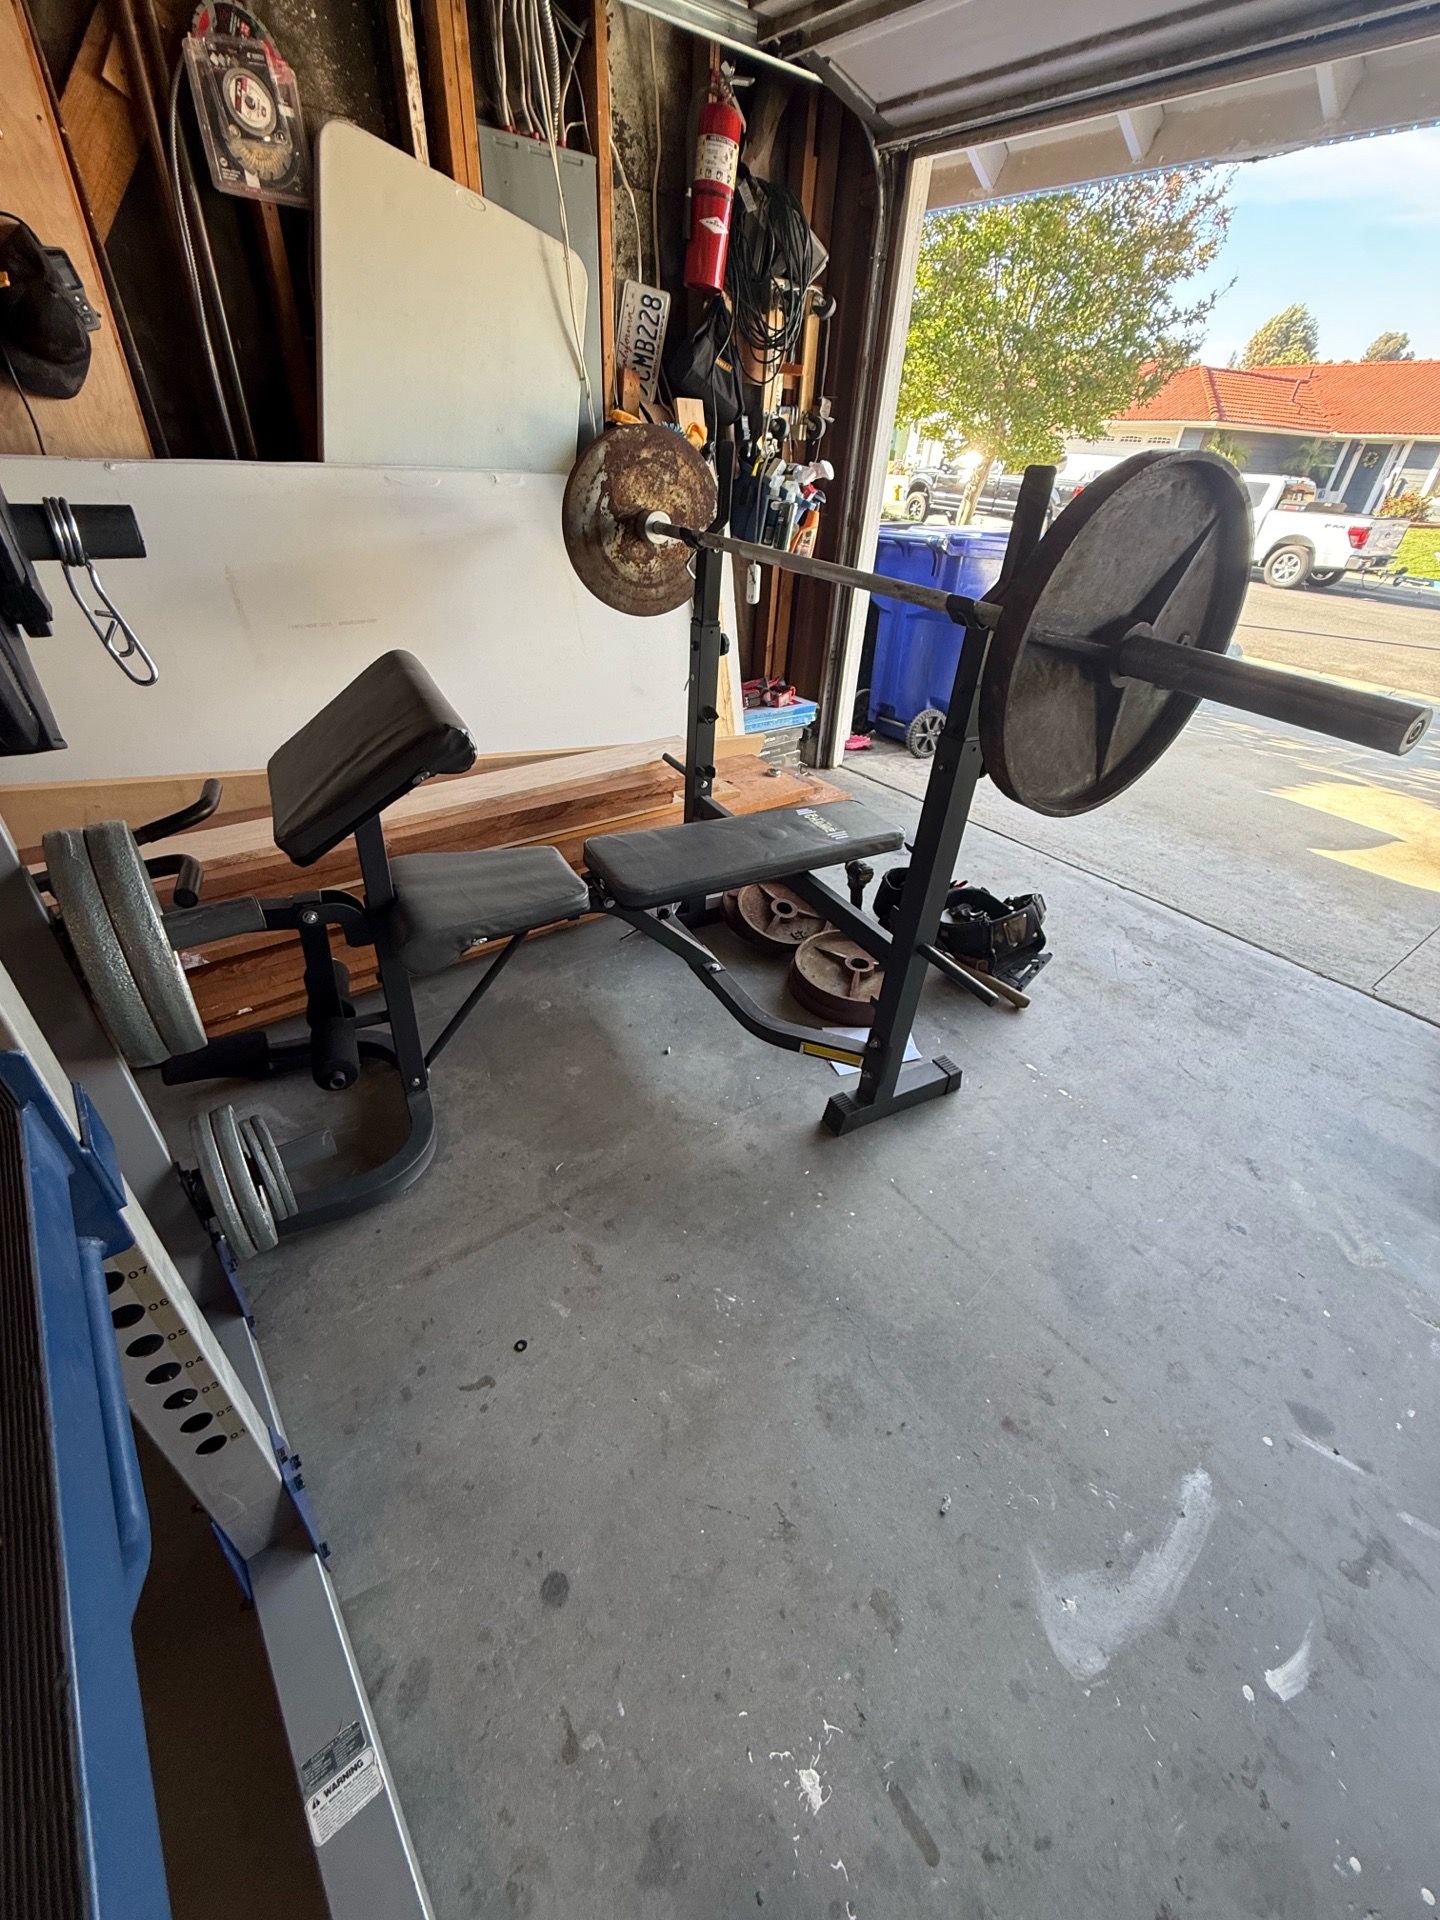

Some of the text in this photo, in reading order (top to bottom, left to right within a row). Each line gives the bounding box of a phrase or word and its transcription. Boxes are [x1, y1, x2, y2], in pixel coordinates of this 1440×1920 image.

[618, 305, 635, 367] alifornia
[128, 1265, 148, 1280] 07
[148, 1298, 169, 1311] 06
[167, 1328, 188, 1341] 05
[185, 1356, 204, 1369] 04
[202, 1381, 220, 1394] 03
[216, 1405, 233, 1417] 02
[230, 1428, 246, 1440] 01
[323, 1759, 364, 1798] WARNING
